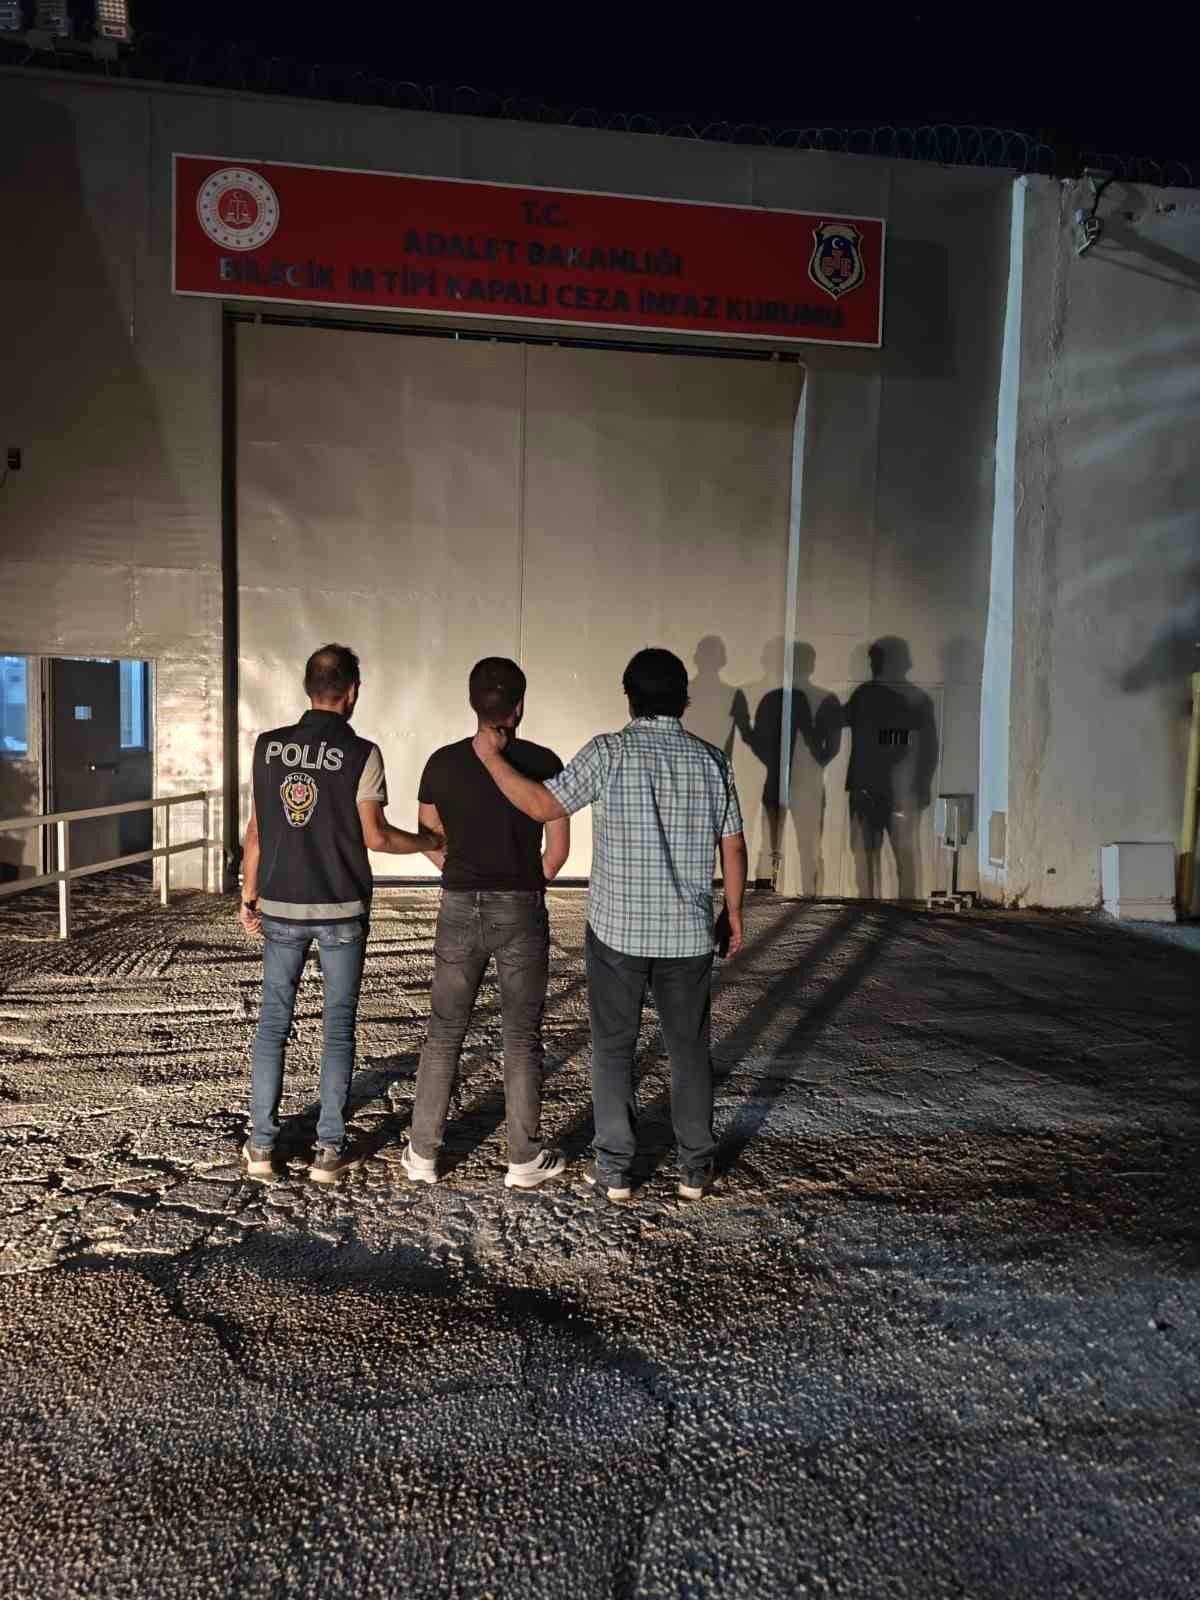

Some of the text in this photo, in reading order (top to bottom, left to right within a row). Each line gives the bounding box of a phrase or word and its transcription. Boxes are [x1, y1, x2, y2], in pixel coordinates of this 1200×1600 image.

[520, 202, 569, 227] T.C.
[404, 230, 683, 278] ADALET BAKANLIĞI
[446, 275, 548, 306] KAPALI
[558, 285, 629, 313] CEZA
[265, 741, 344, 771] POLİS
